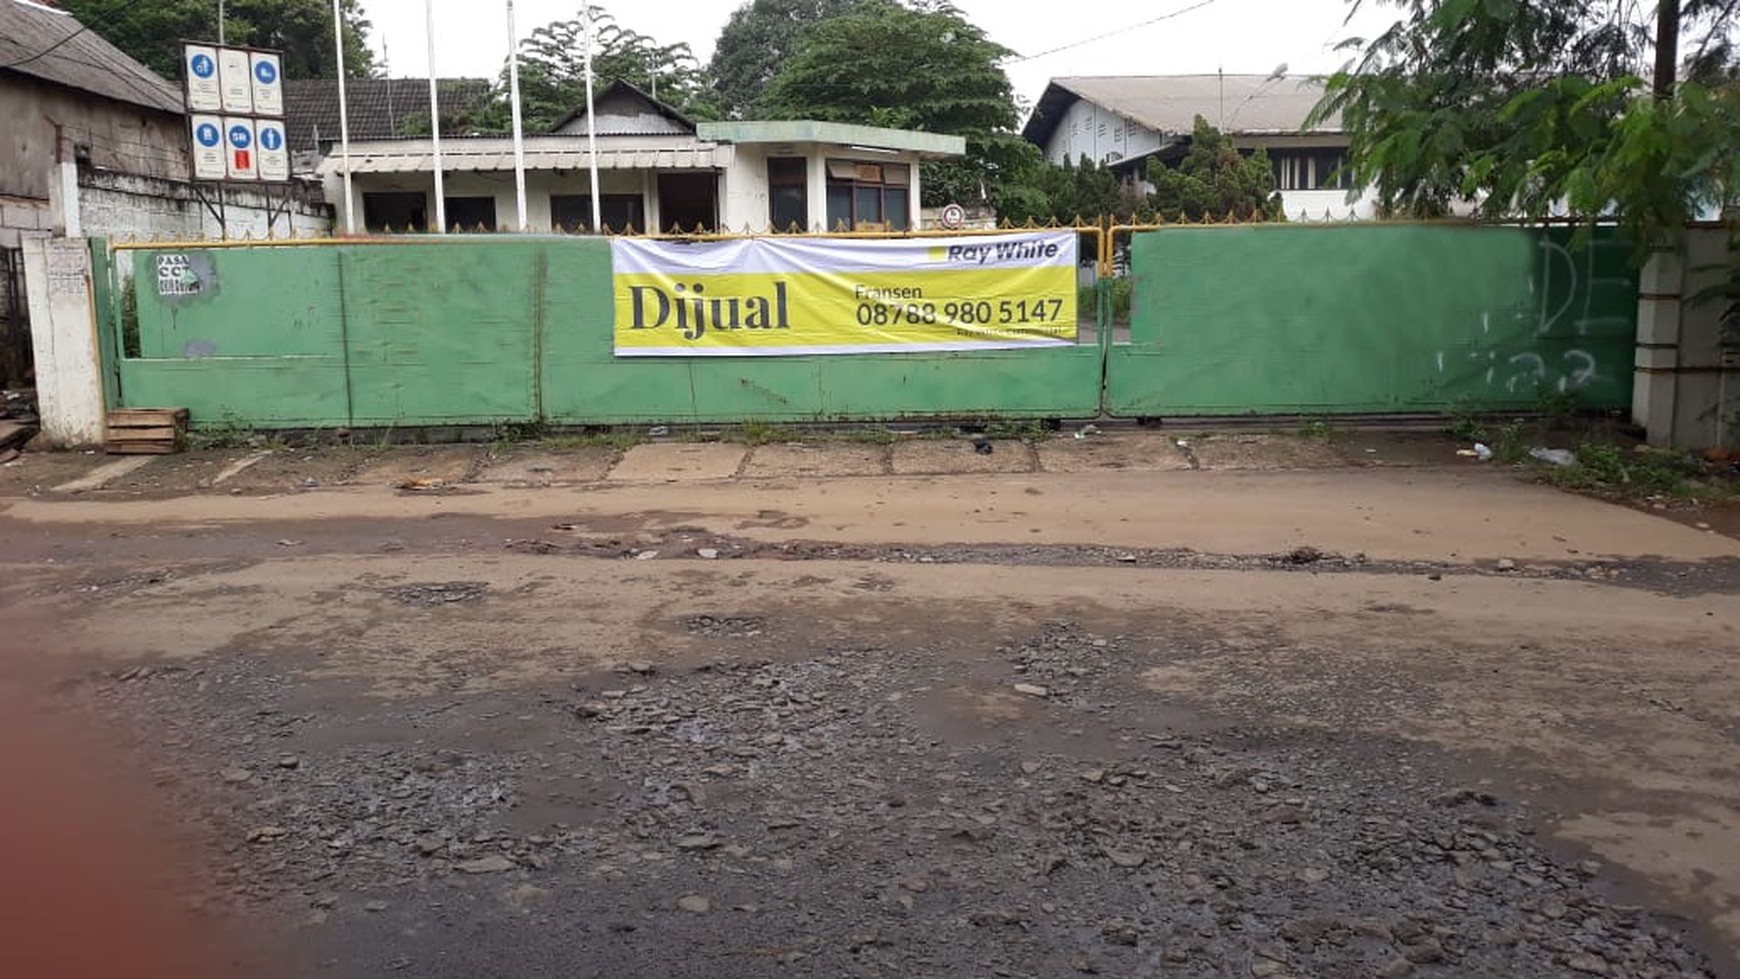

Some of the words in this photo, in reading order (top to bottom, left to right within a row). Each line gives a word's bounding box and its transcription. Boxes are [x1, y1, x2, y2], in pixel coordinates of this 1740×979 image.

[948, 245, 992, 264] Ray
[996, 240, 1059, 259] White
[855, 285, 922, 300] Fransen
[629, 281, 789, 340] Dijual
[856, 303, 937, 326] 08788
[944, 301, 992, 324] 980
[1000, 299, 1064, 323] 5147
